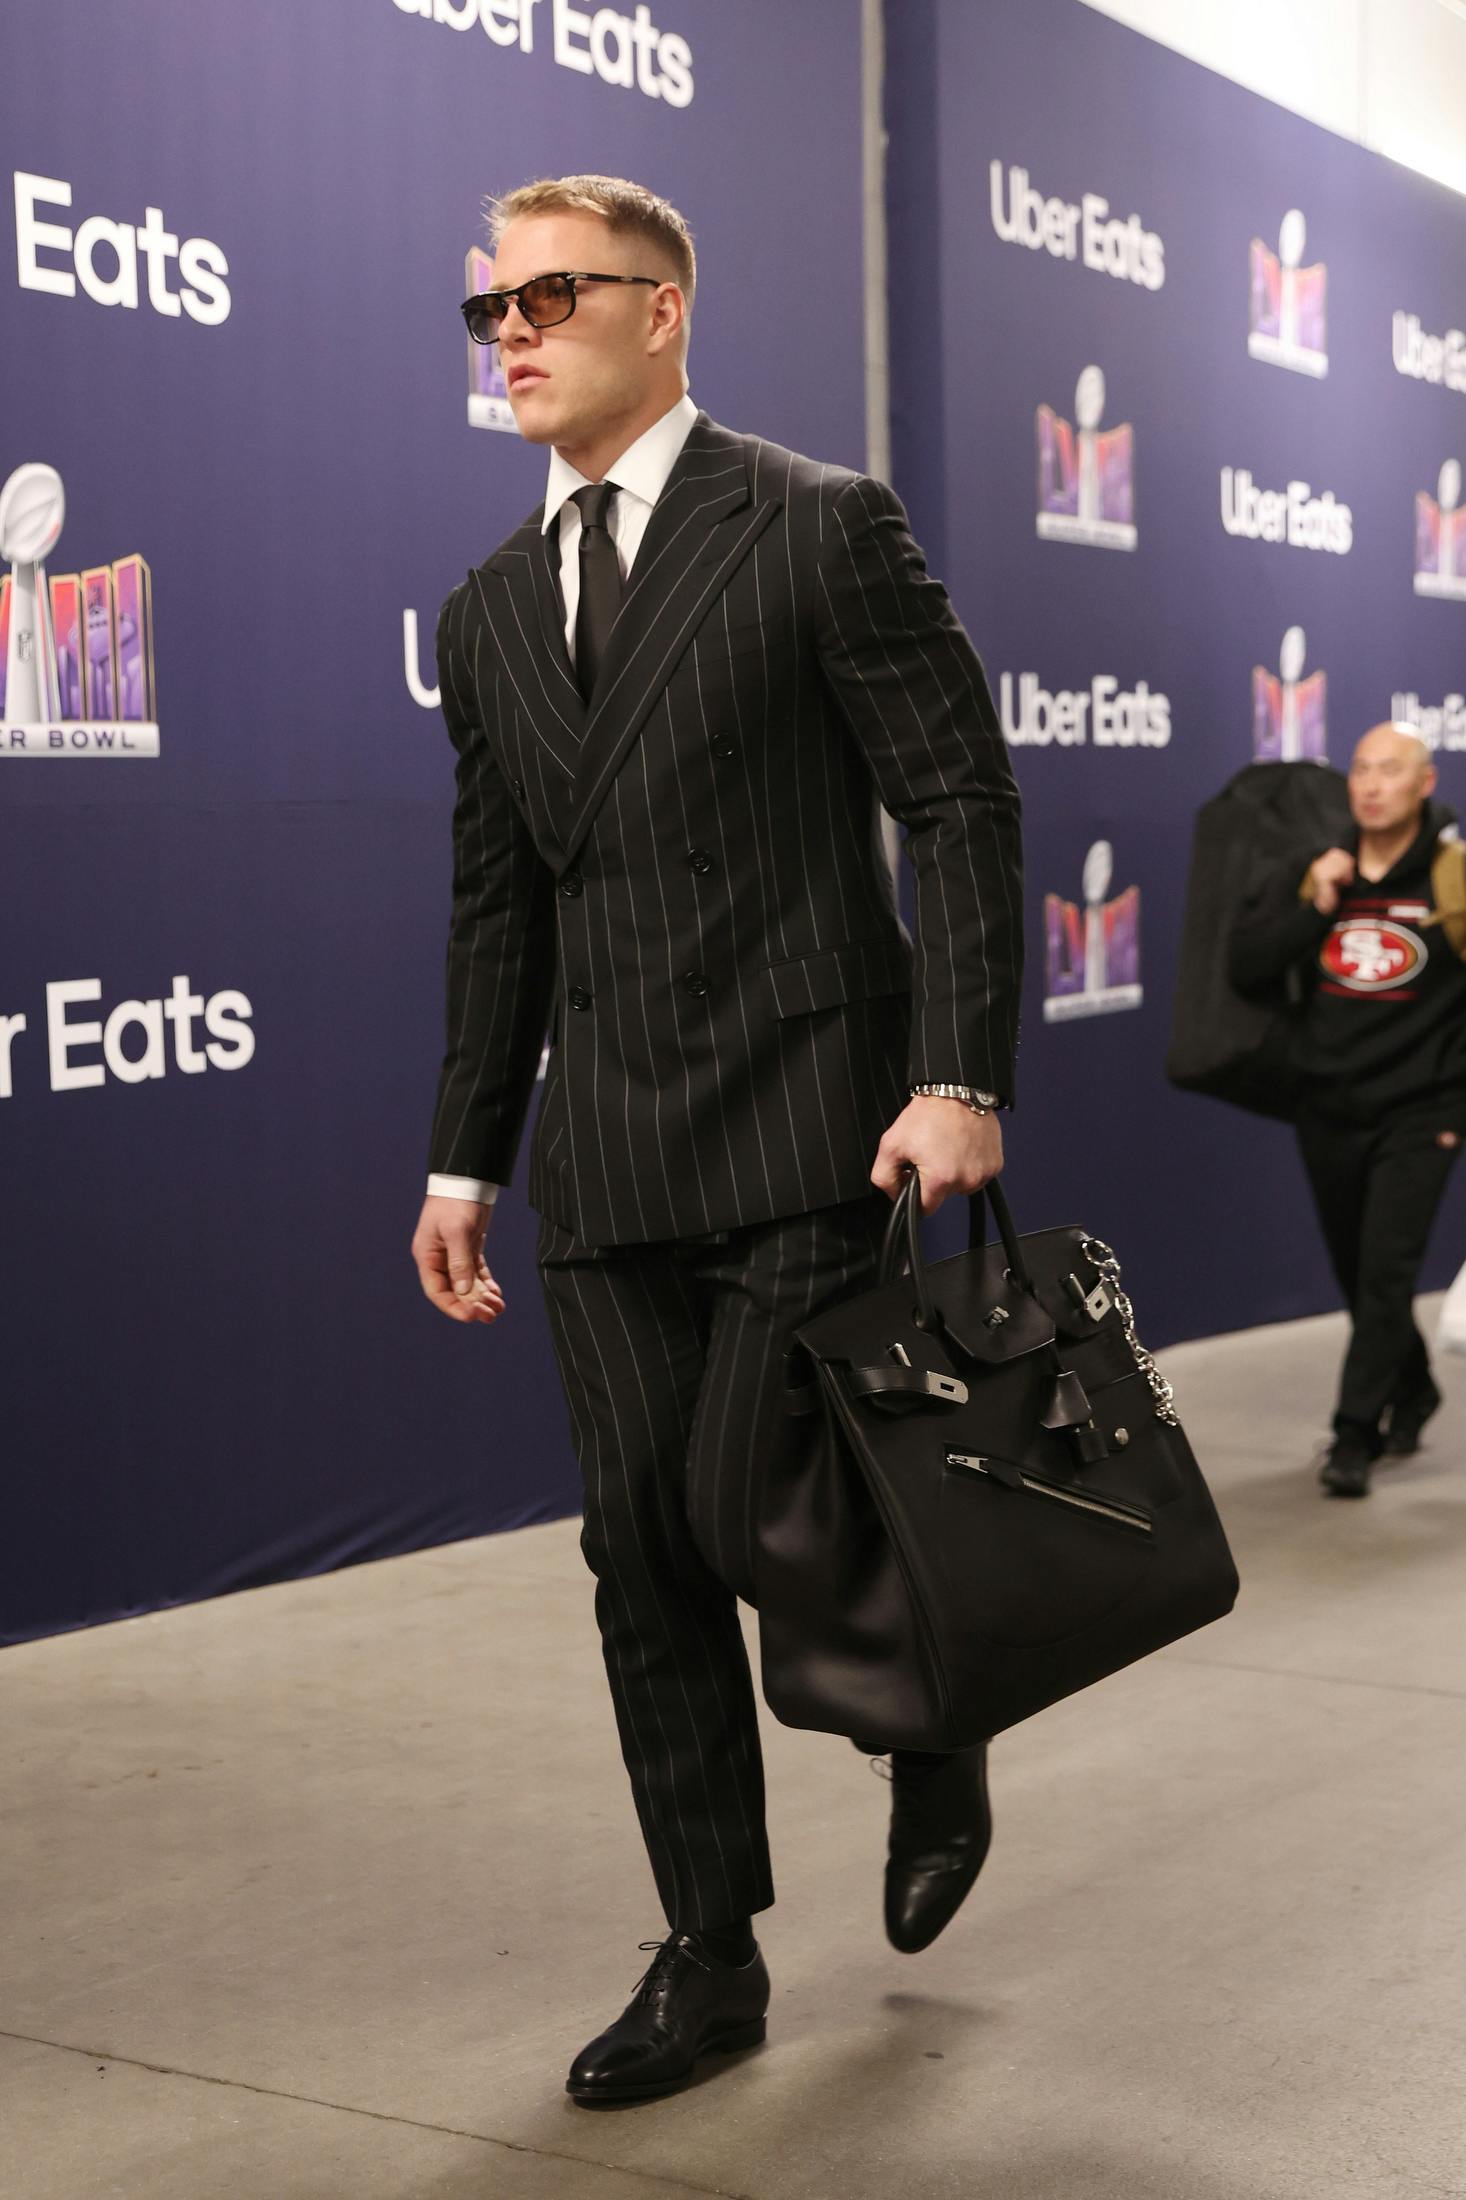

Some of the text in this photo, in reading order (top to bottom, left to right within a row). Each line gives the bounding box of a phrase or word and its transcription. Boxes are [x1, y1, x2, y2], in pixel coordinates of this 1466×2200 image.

[552, 0, 695, 108] Eats
[13, 171, 232, 326] Eats
[990, 159, 1165, 291] Uber Eats
[1220, 466, 1353, 555] Uber Eats
[49, 730, 136, 749] BOWL
[1000, 671, 1171, 748] Uber Eats
[46, 976, 256, 1092] Eats
